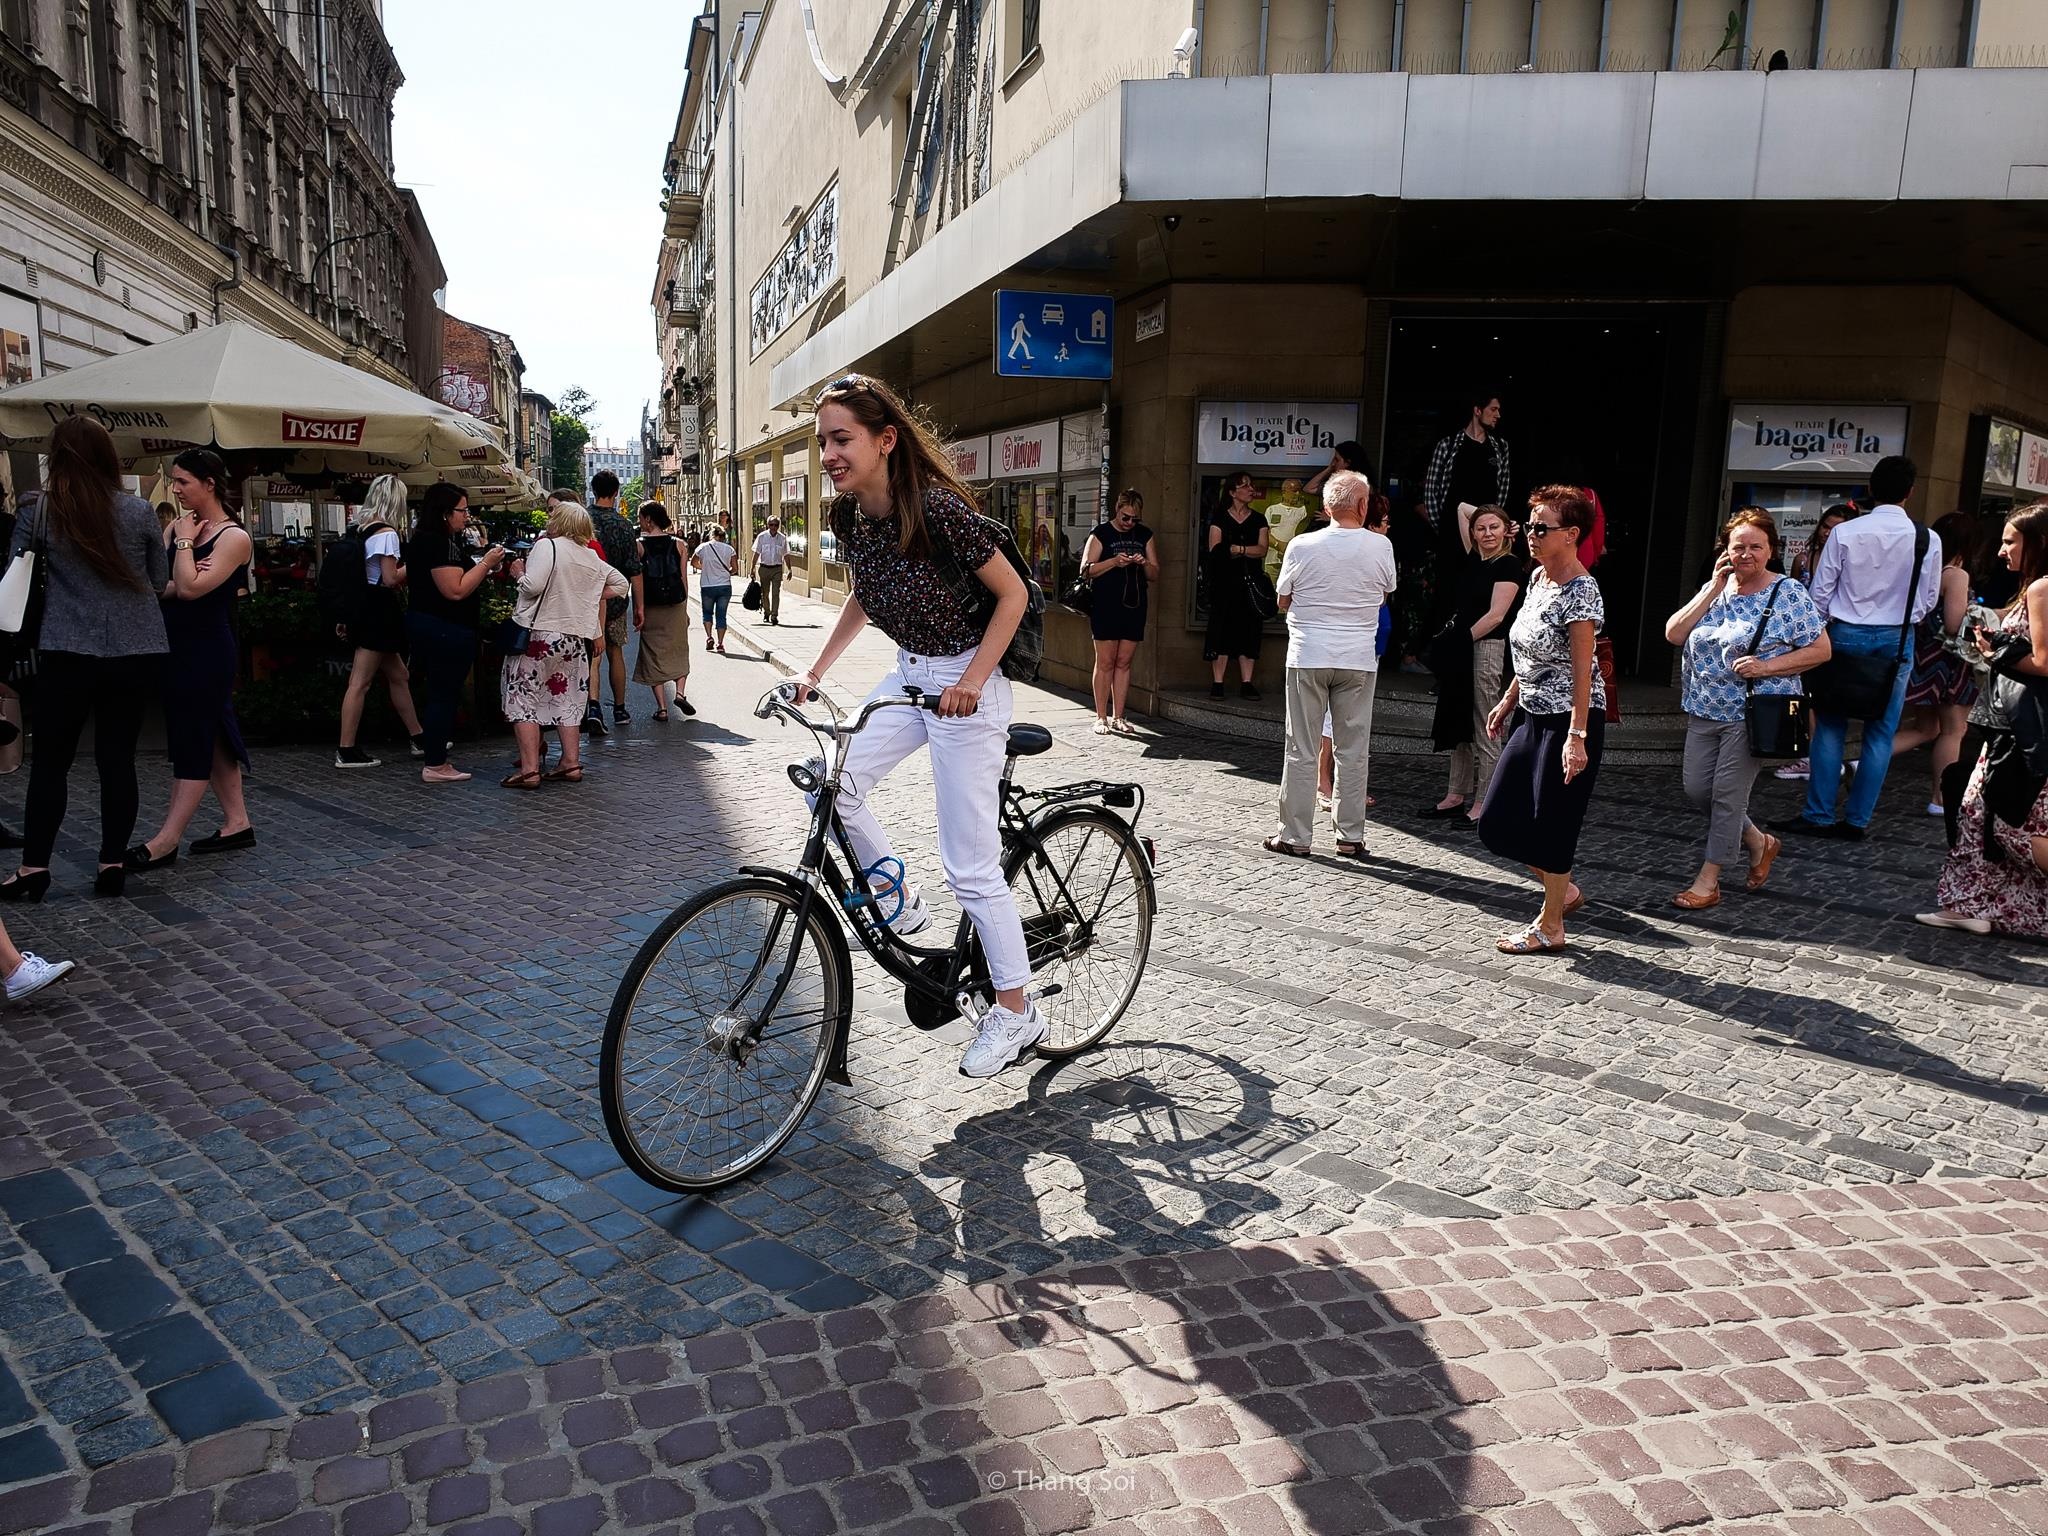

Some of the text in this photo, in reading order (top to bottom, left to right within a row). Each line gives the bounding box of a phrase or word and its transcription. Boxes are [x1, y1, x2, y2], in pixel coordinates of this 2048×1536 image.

[287, 418, 359, 441] TYSKIE
[1220, 414, 1337, 455] bagatela
[1256, 417, 1284, 425] TEATR
[1795, 421, 1825, 429] TEATR
[1755, 417, 1880, 460] bagatela
[1013, 439, 1042, 470] MAYDAY
[856, 908, 884, 950] ZELLE
